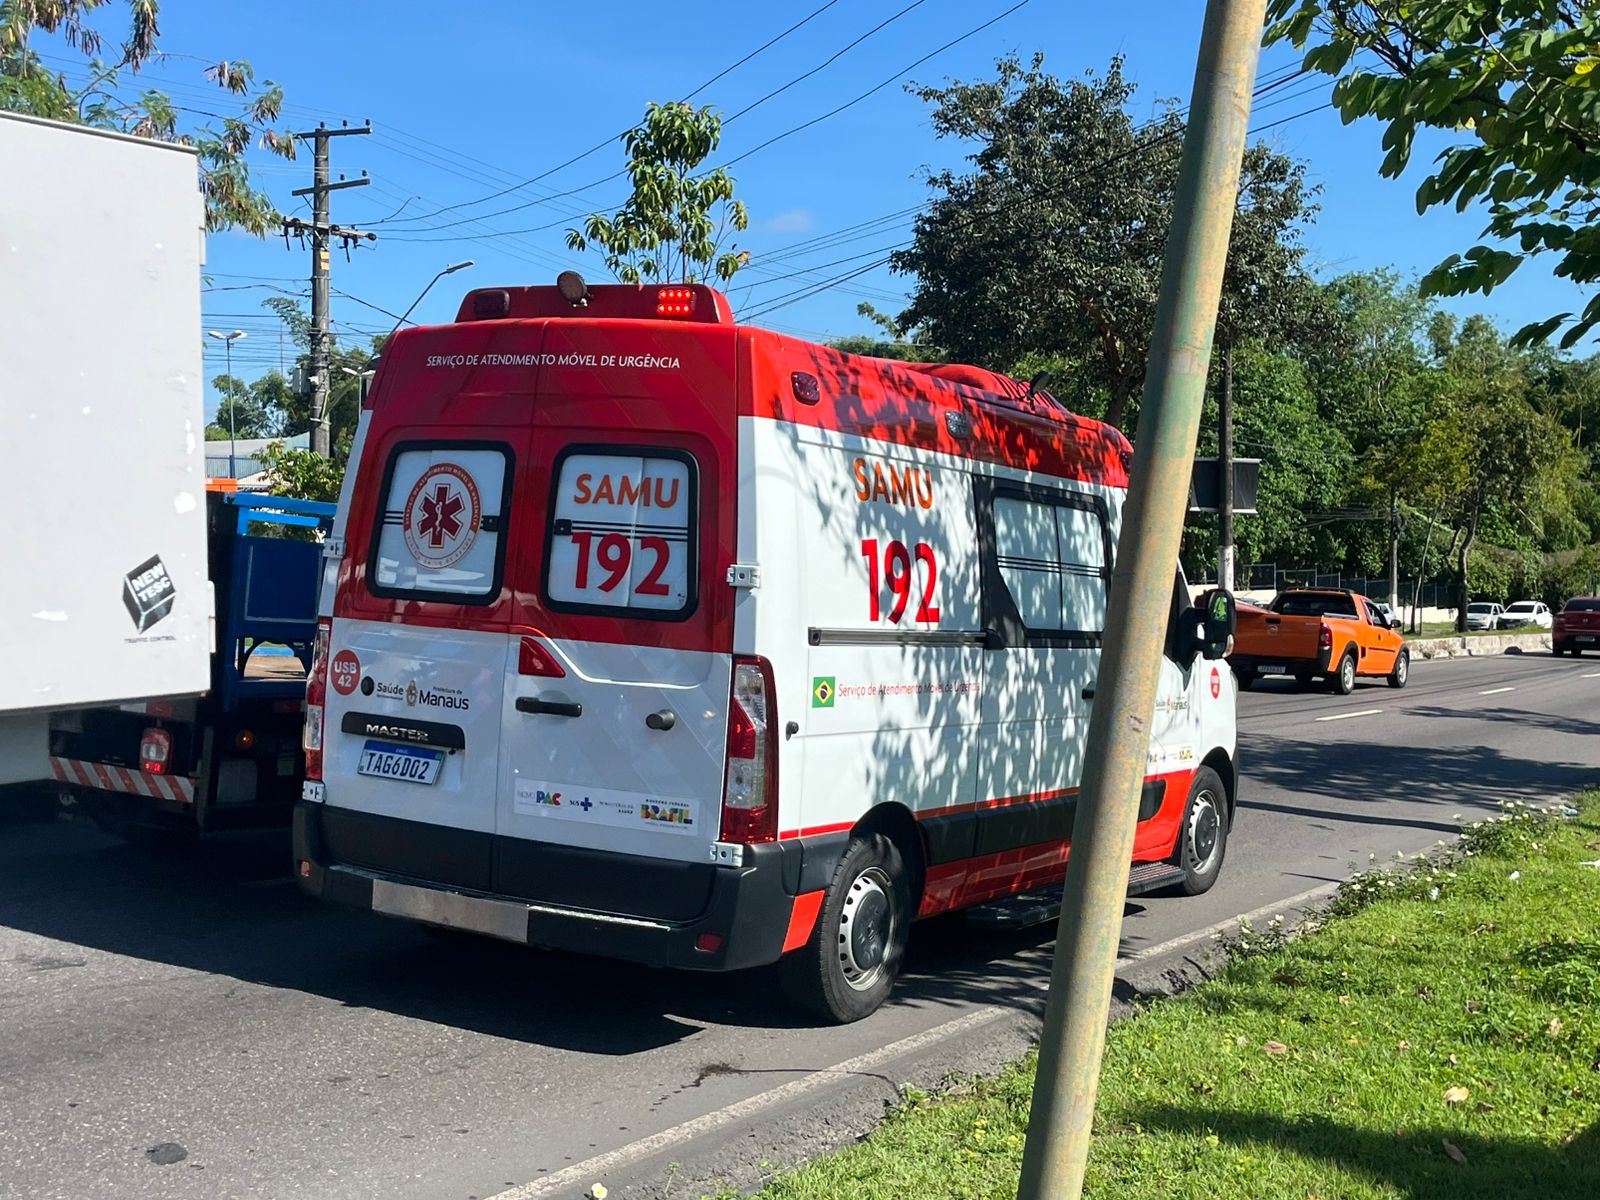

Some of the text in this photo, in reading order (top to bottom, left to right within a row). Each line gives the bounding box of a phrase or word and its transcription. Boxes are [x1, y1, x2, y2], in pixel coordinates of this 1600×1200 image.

[426, 352, 681, 369] SERVIÇO DE ATENDIMENTO MÓVEL DE URGÊNCIA
[574, 473, 680, 508] SAMU
[853, 457, 933, 509] SAMU
[571, 532, 671, 596] 192
[131, 562, 165, 591] NEW
[861, 539, 940, 624] 192
[334, 661, 357, 674] USB
[338, 675, 352, 687] 42
[376, 682, 404, 695] Saúde
[838, 683, 865, 697] Serviço
[867, 682, 877, 696] de
[878, 681, 922, 695] Atendimento
[418, 690, 470, 710] Manaus
[366, 724, 428, 741] MASTER
[366, 752, 430, 780] TAG6D02
[536, 790, 562, 806] PAC
[641, 804, 693, 825] BRASIL
